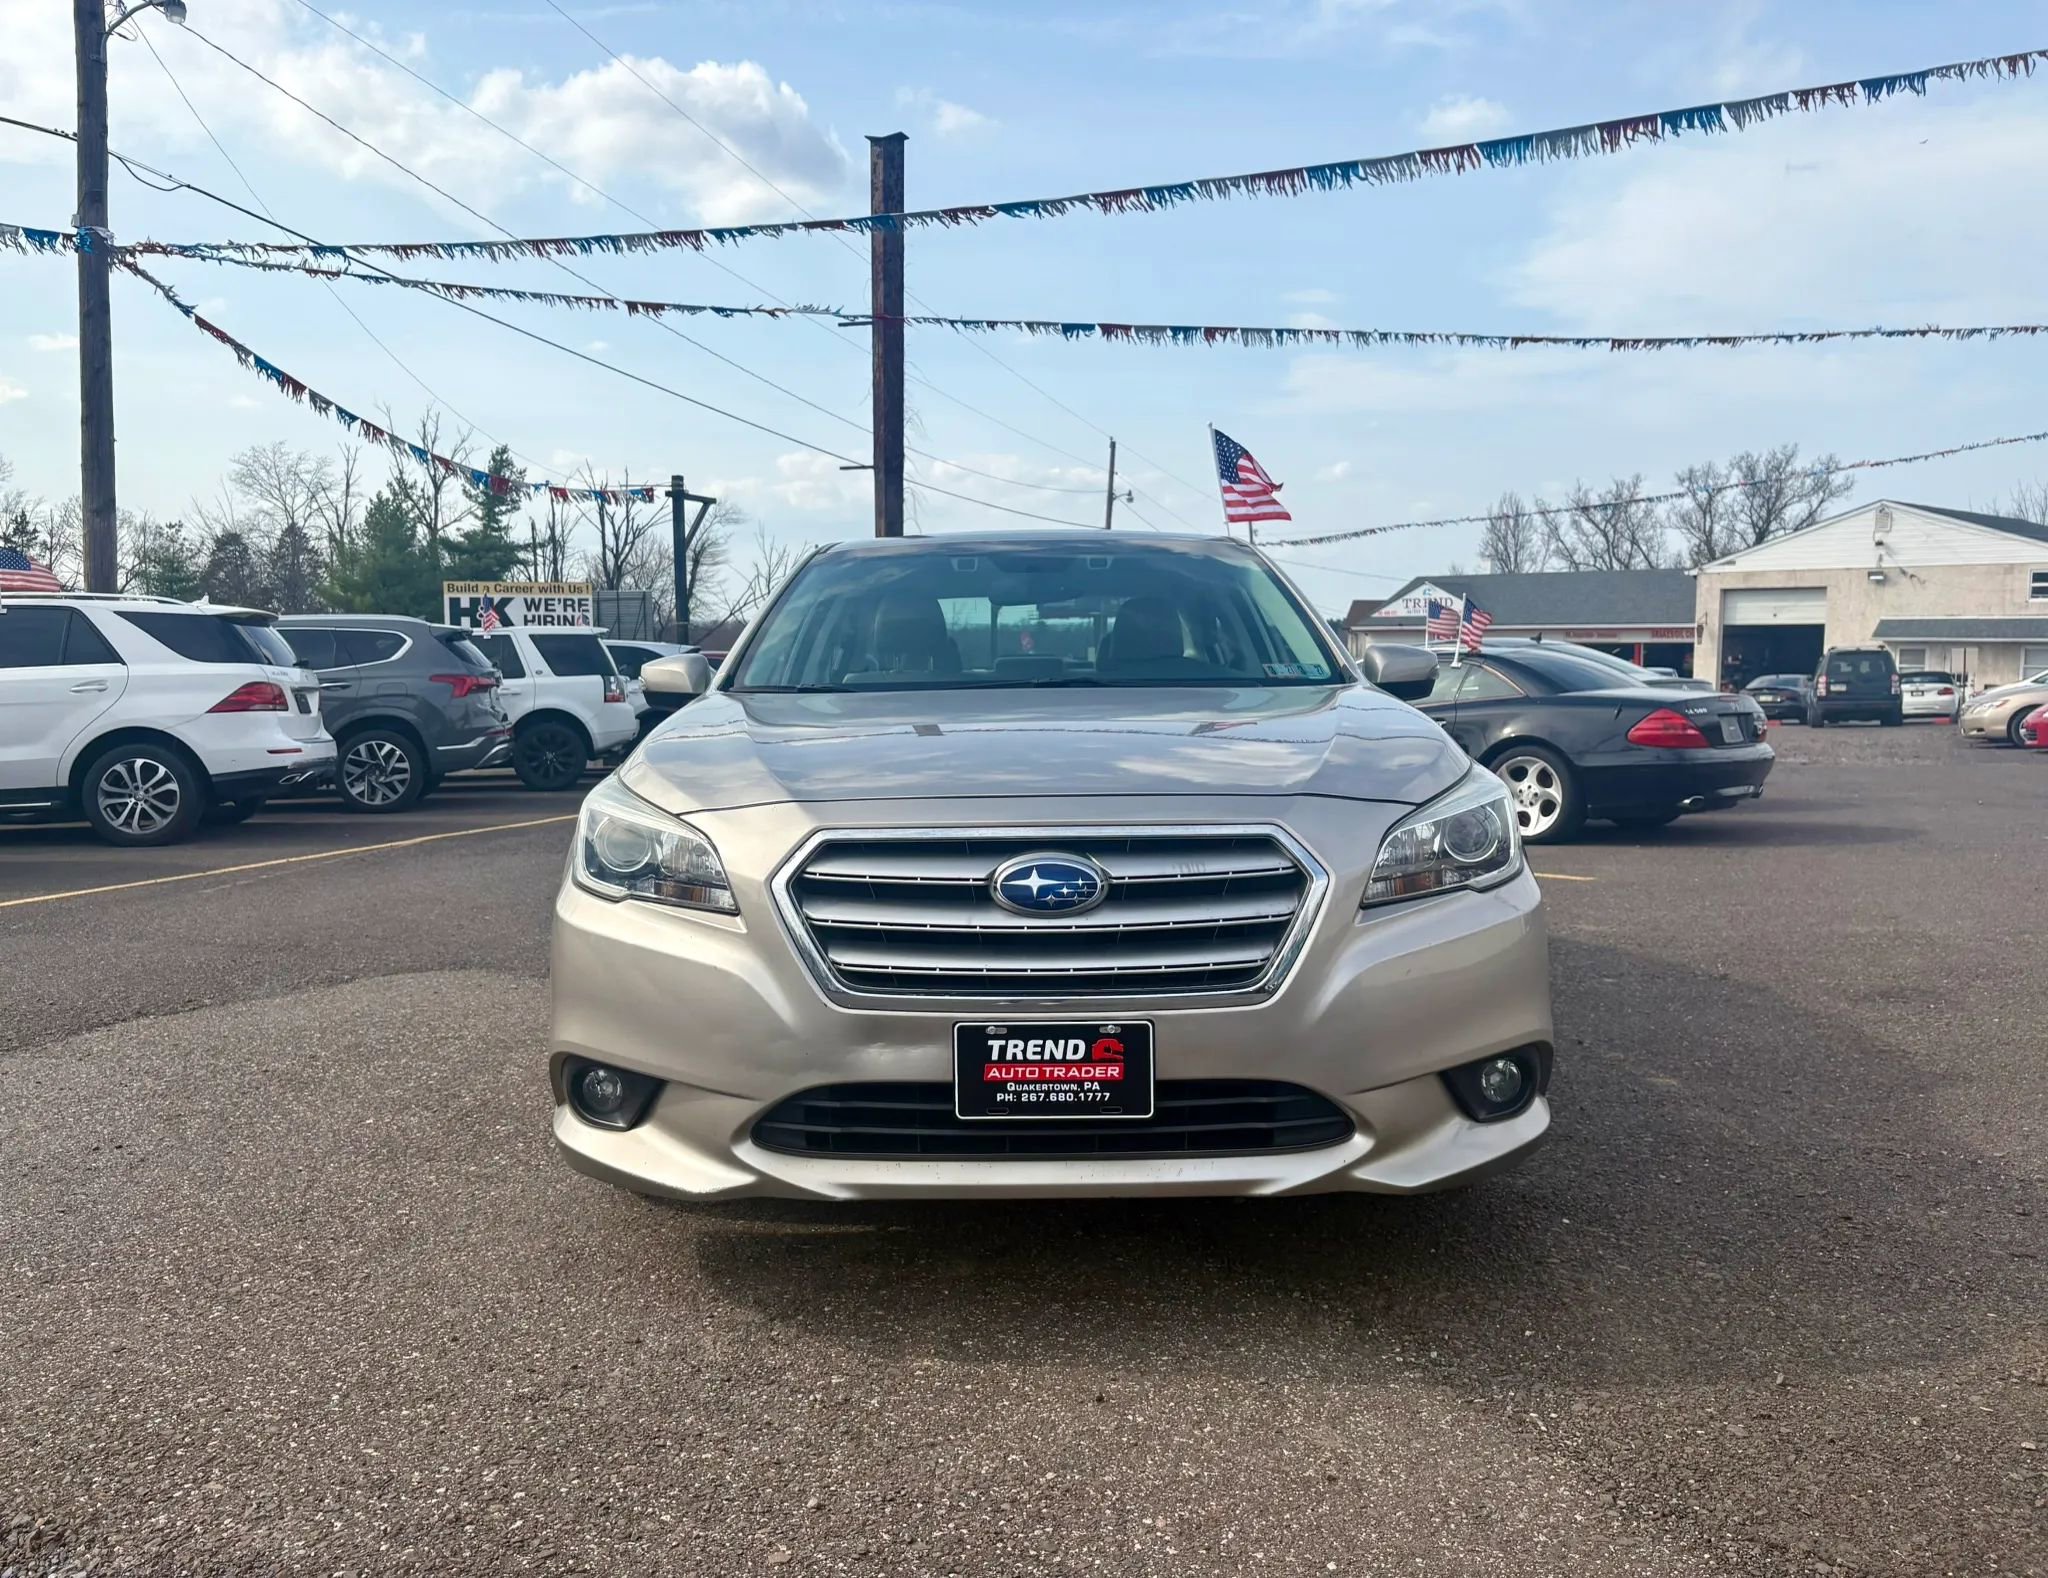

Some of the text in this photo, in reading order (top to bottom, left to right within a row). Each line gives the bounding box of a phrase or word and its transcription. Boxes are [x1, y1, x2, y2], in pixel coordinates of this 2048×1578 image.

[447, 583, 479, 593] Build
[483, 585, 490, 593] a
[494, 583, 534, 593] Career
[538, 584, 564, 594] with
[523, 597, 590, 613] WE'RE
[987, 1039, 1086, 1061] TREND
[987, 1066, 1120, 1078] AUTO TRADER
[1084, 1082, 1100, 1090] PA
[996, 1092, 1110, 1102] PH: 267.680.1777
